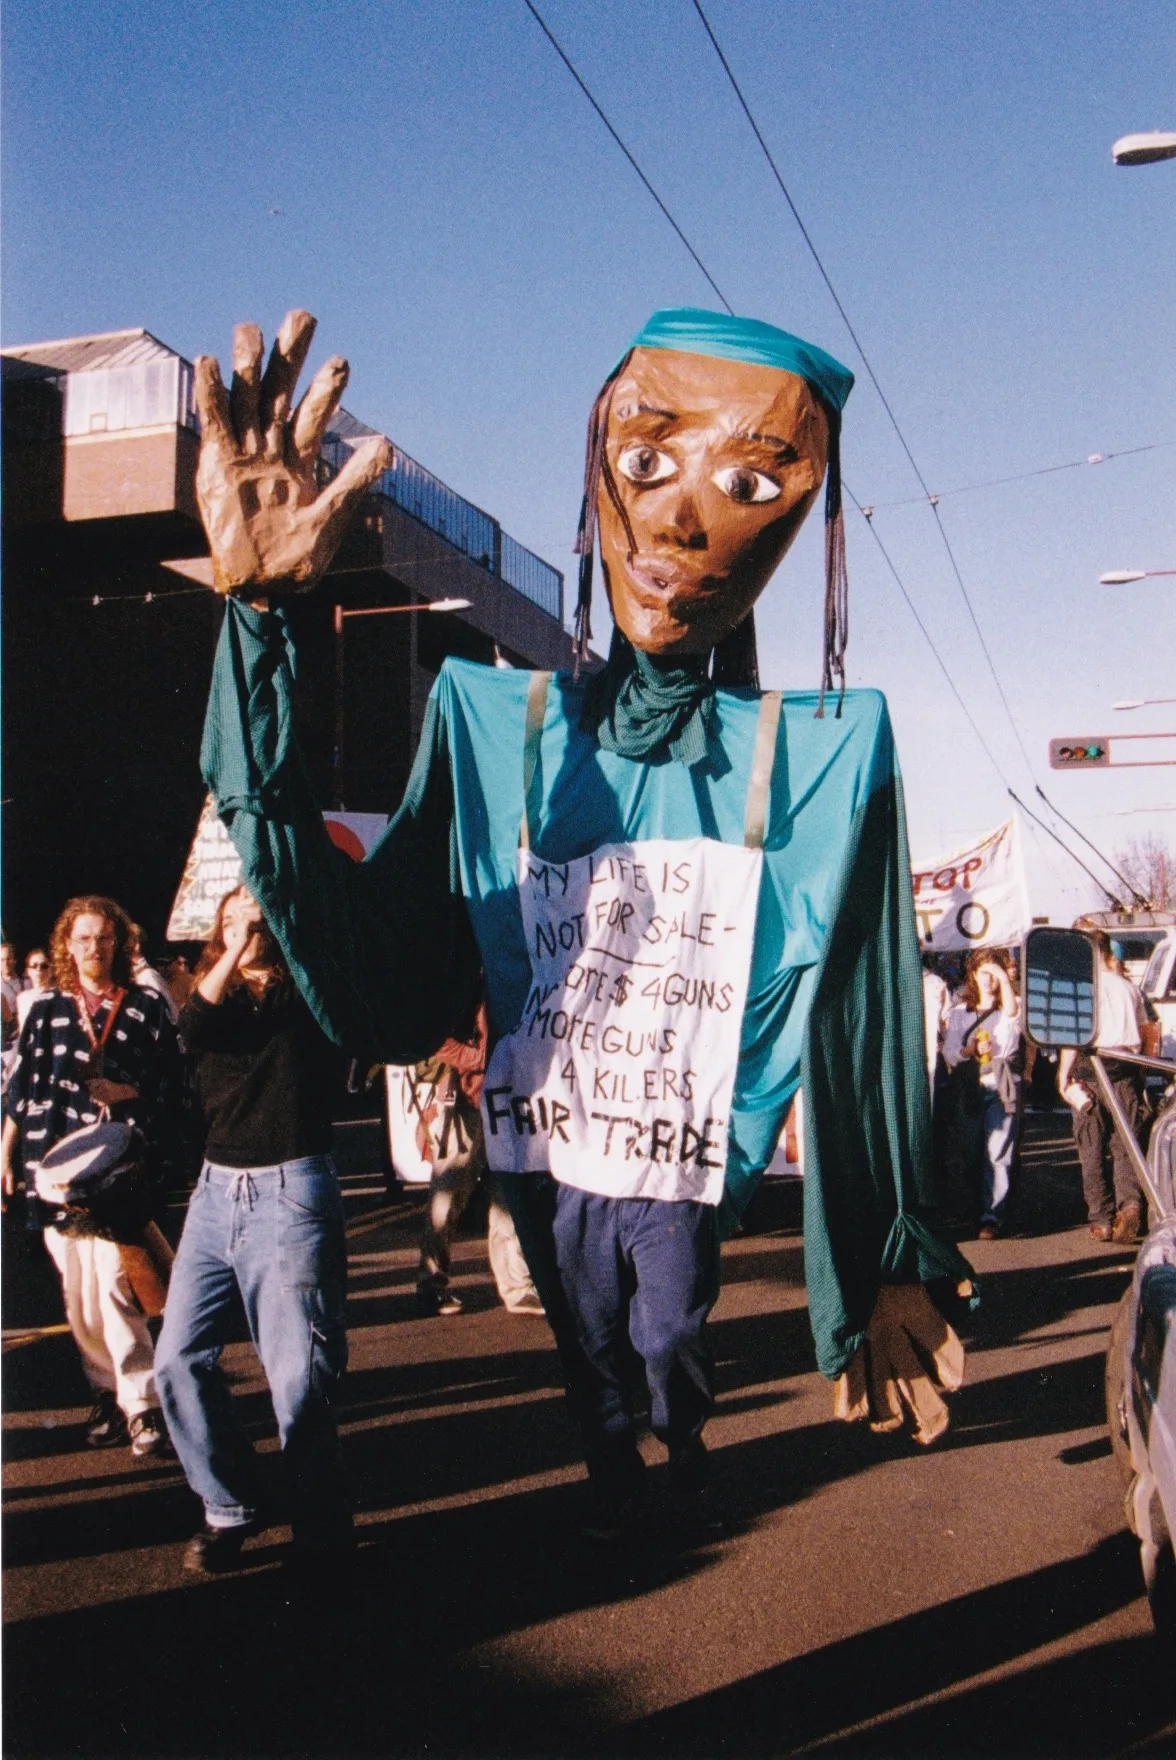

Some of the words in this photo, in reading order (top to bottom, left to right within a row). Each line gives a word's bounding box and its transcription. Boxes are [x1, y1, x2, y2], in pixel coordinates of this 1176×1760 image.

[528, 864, 569, 899] MY
[588, 856, 646, 892] LIFE
[661, 861, 692, 893] IS
[912, 857, 982, 896] TOP
[535, 913, 585, 959] NOT
[595, 898, 635, 934] FOR
[916, 901, 990, 942] TO
[601, 1024, 677, 1057] GUNS
[560, 1058, 577, 1094] 4
[484, 1086, 571, 1144] FAIR
[591, 1112, 724, 1169] TRADE
